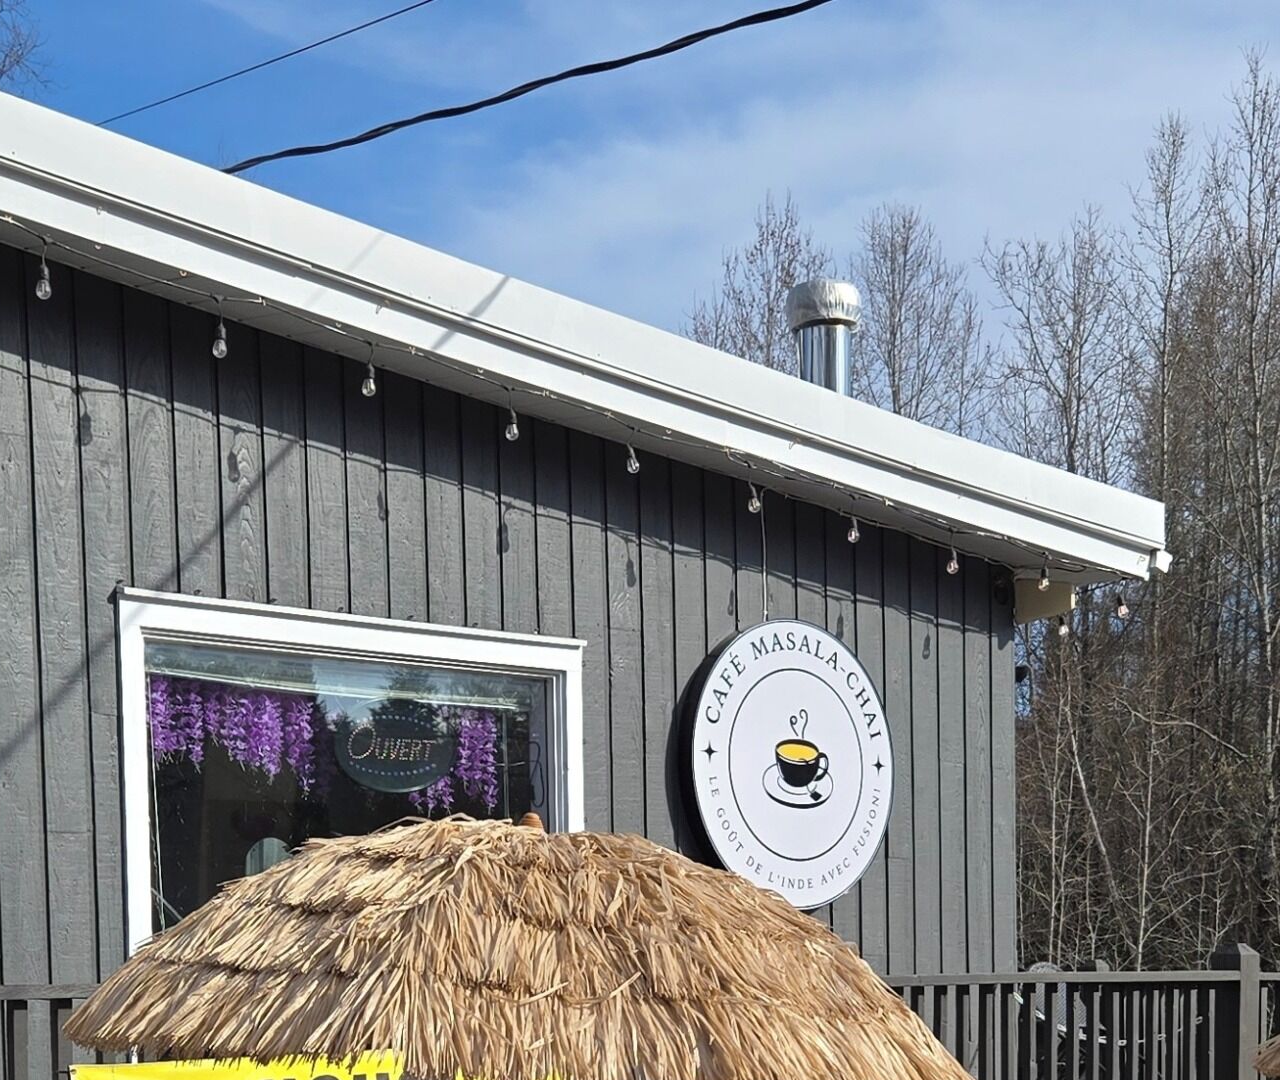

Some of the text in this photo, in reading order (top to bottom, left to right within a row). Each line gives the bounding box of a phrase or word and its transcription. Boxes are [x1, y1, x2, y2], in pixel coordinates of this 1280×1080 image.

[705, 632, 882, 740] CAFÉ MASALA-CHAI
[709, 776, 720, 797] LE
[746, 856, 763, 875] DE
[768, 871, 813, 889] L'INDE
[821, 857, 850, 885] AVEC
